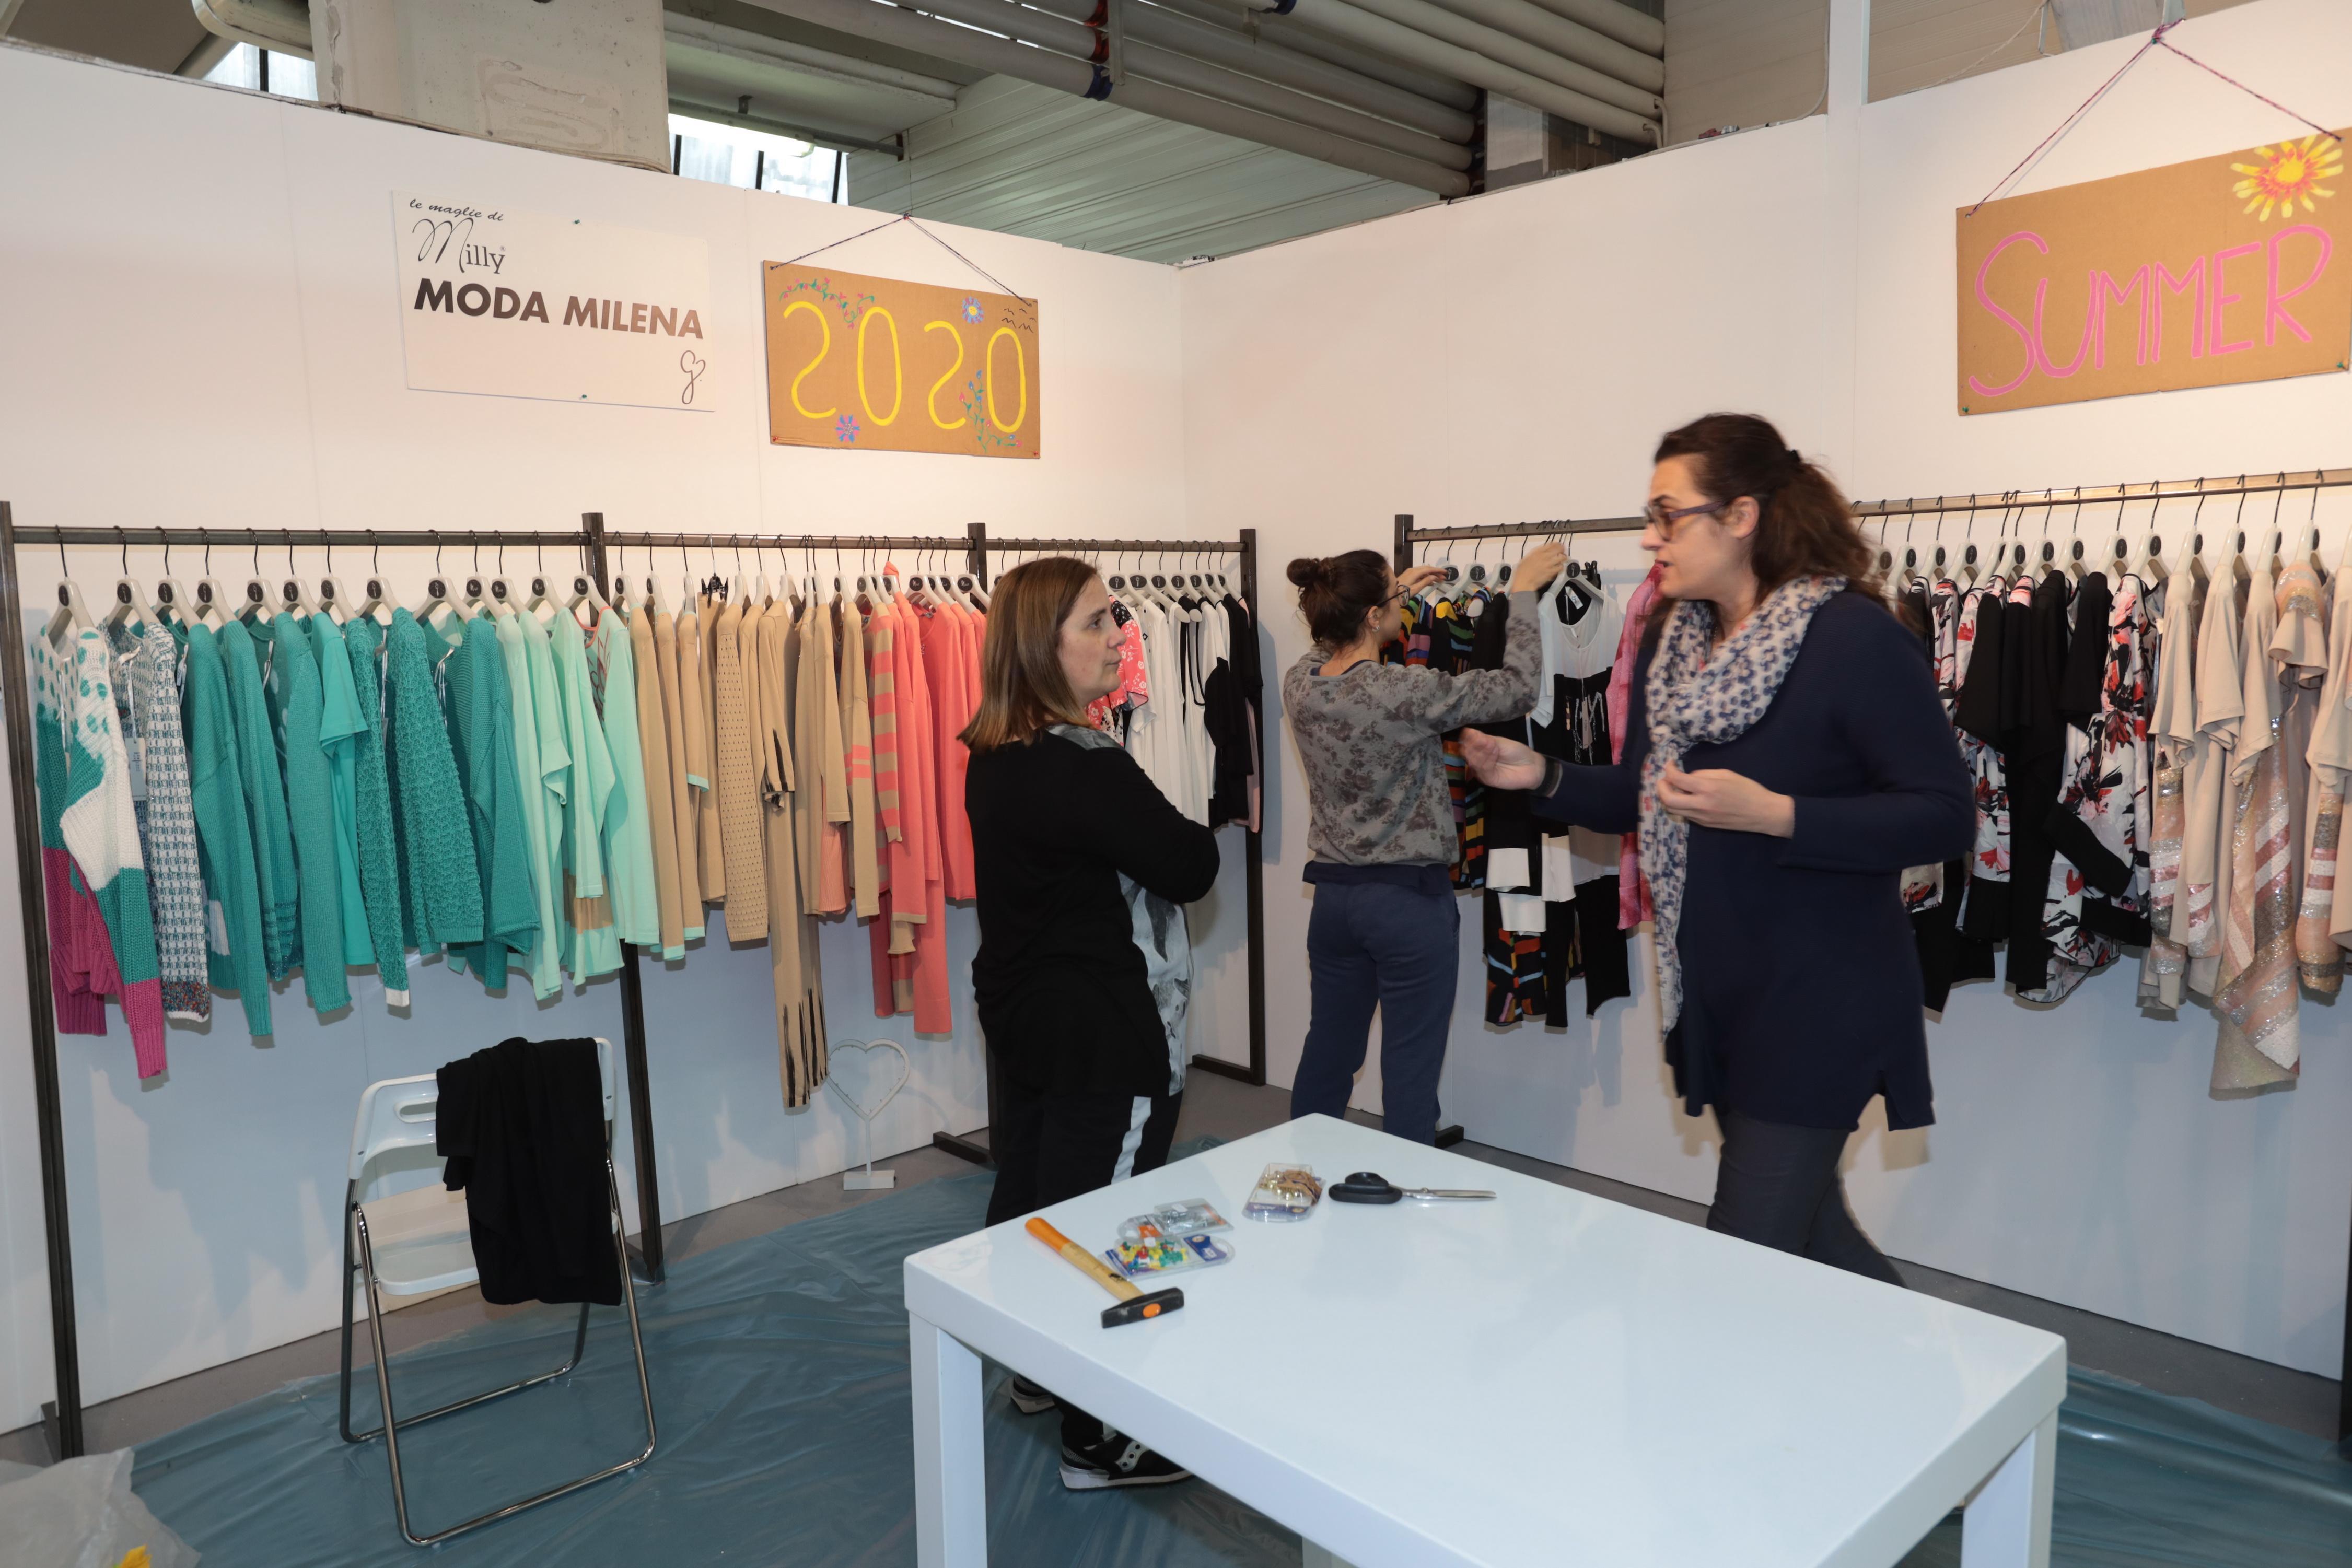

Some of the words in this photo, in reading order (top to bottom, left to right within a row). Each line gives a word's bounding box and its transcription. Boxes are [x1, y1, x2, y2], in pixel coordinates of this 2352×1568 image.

[409, 198, 423, 209] le
[428, 203, 482, 218] maglie
[487, 210, 504, 222] di
[414, 278, 550, 324] MODA
[563, 295, 704, 340] MILENA
[1969, 224, 2333, 397] SUMMER
[783, 301, 1027, 433] 2020
